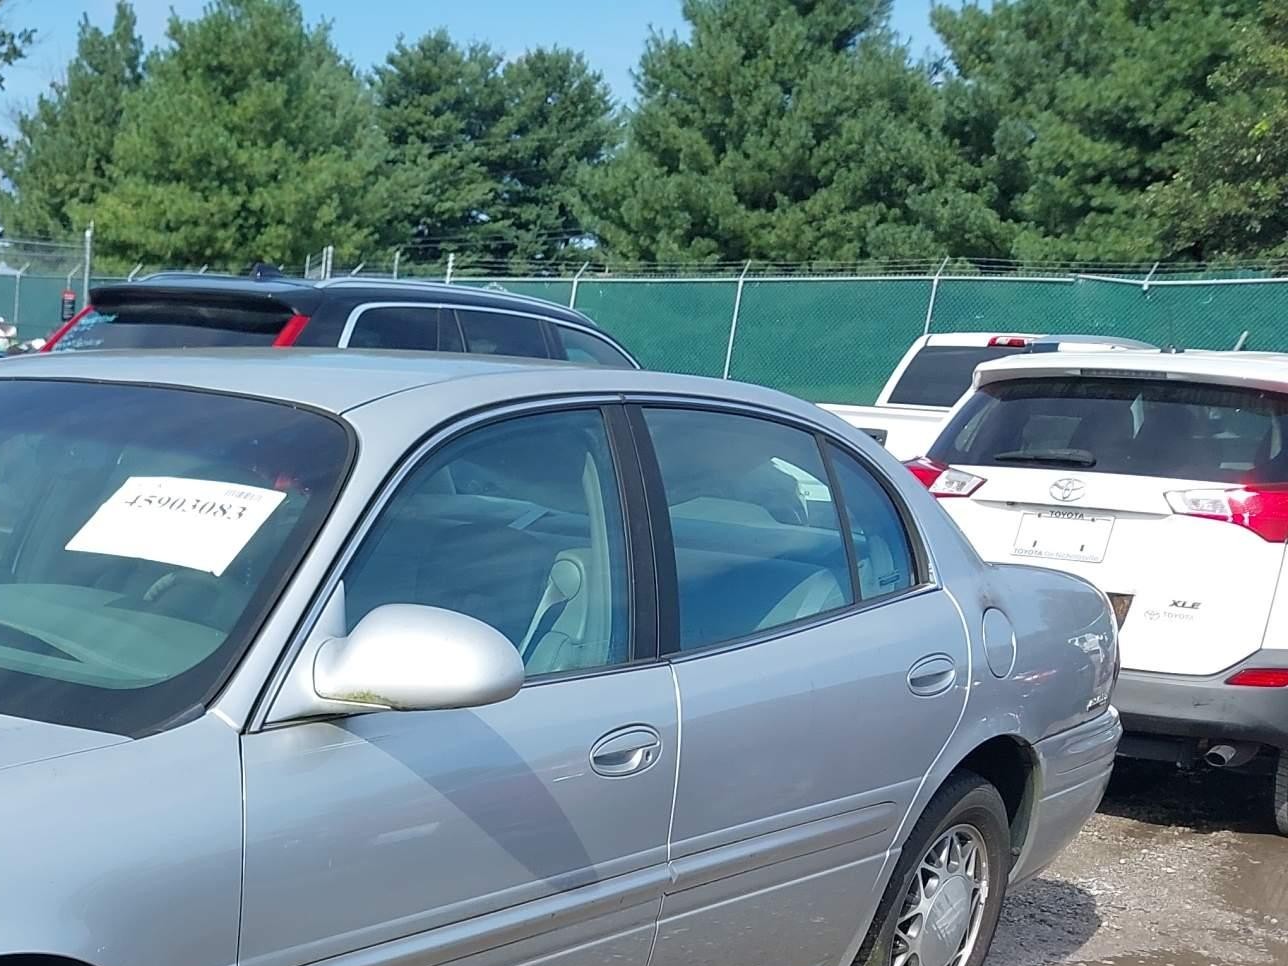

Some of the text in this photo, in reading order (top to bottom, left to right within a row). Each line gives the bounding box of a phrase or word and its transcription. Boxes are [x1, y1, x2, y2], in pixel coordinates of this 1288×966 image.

[123, 494, 249, 521] 45903083
[1049, 510, 1085, 519] TOYOTA
[1169, 600, 1202, 609] XLE
